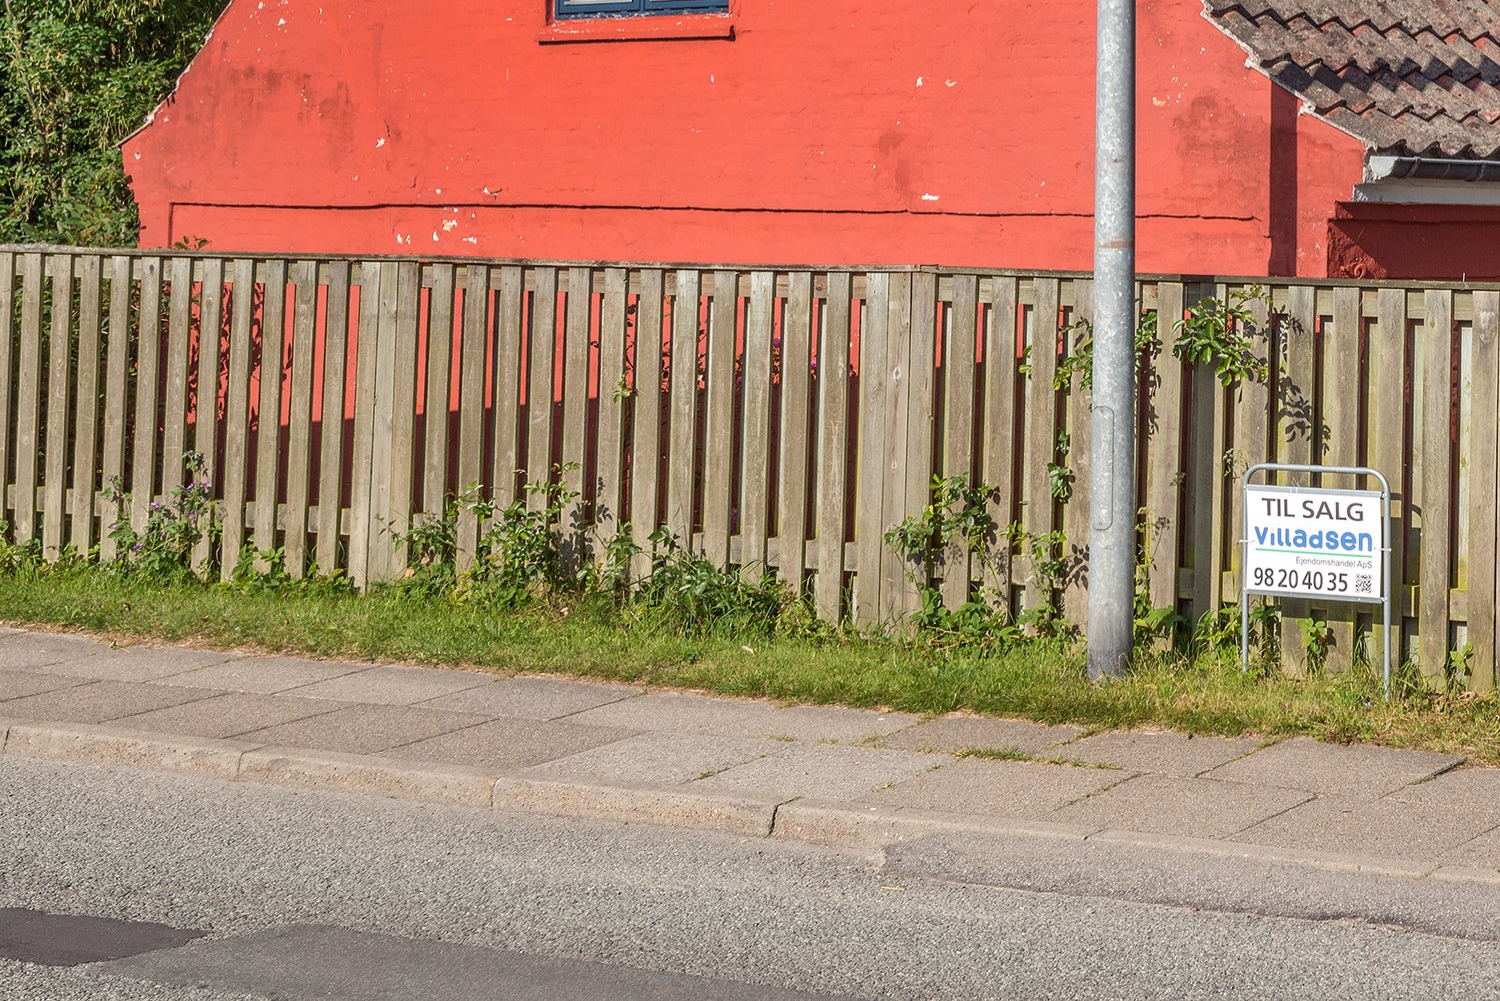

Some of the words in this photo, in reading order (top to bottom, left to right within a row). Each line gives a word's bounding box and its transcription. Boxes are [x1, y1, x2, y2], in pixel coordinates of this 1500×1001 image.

[1262, 498, 1295, 517] TIL
[1302, 500, 1364, 521] SALG
[1254, 526, 1373, 552] Villadsen
[1296, 556, 1356, 568] Ejendomshandel
[1357, 559, 1373, 569] ApS
[1254, 567, 1274, 587] 98
[1278, 569, 1299, 588] 20
[1302, 571, 1323, 590] 40
[1327, 572, 1348, 592] 35
